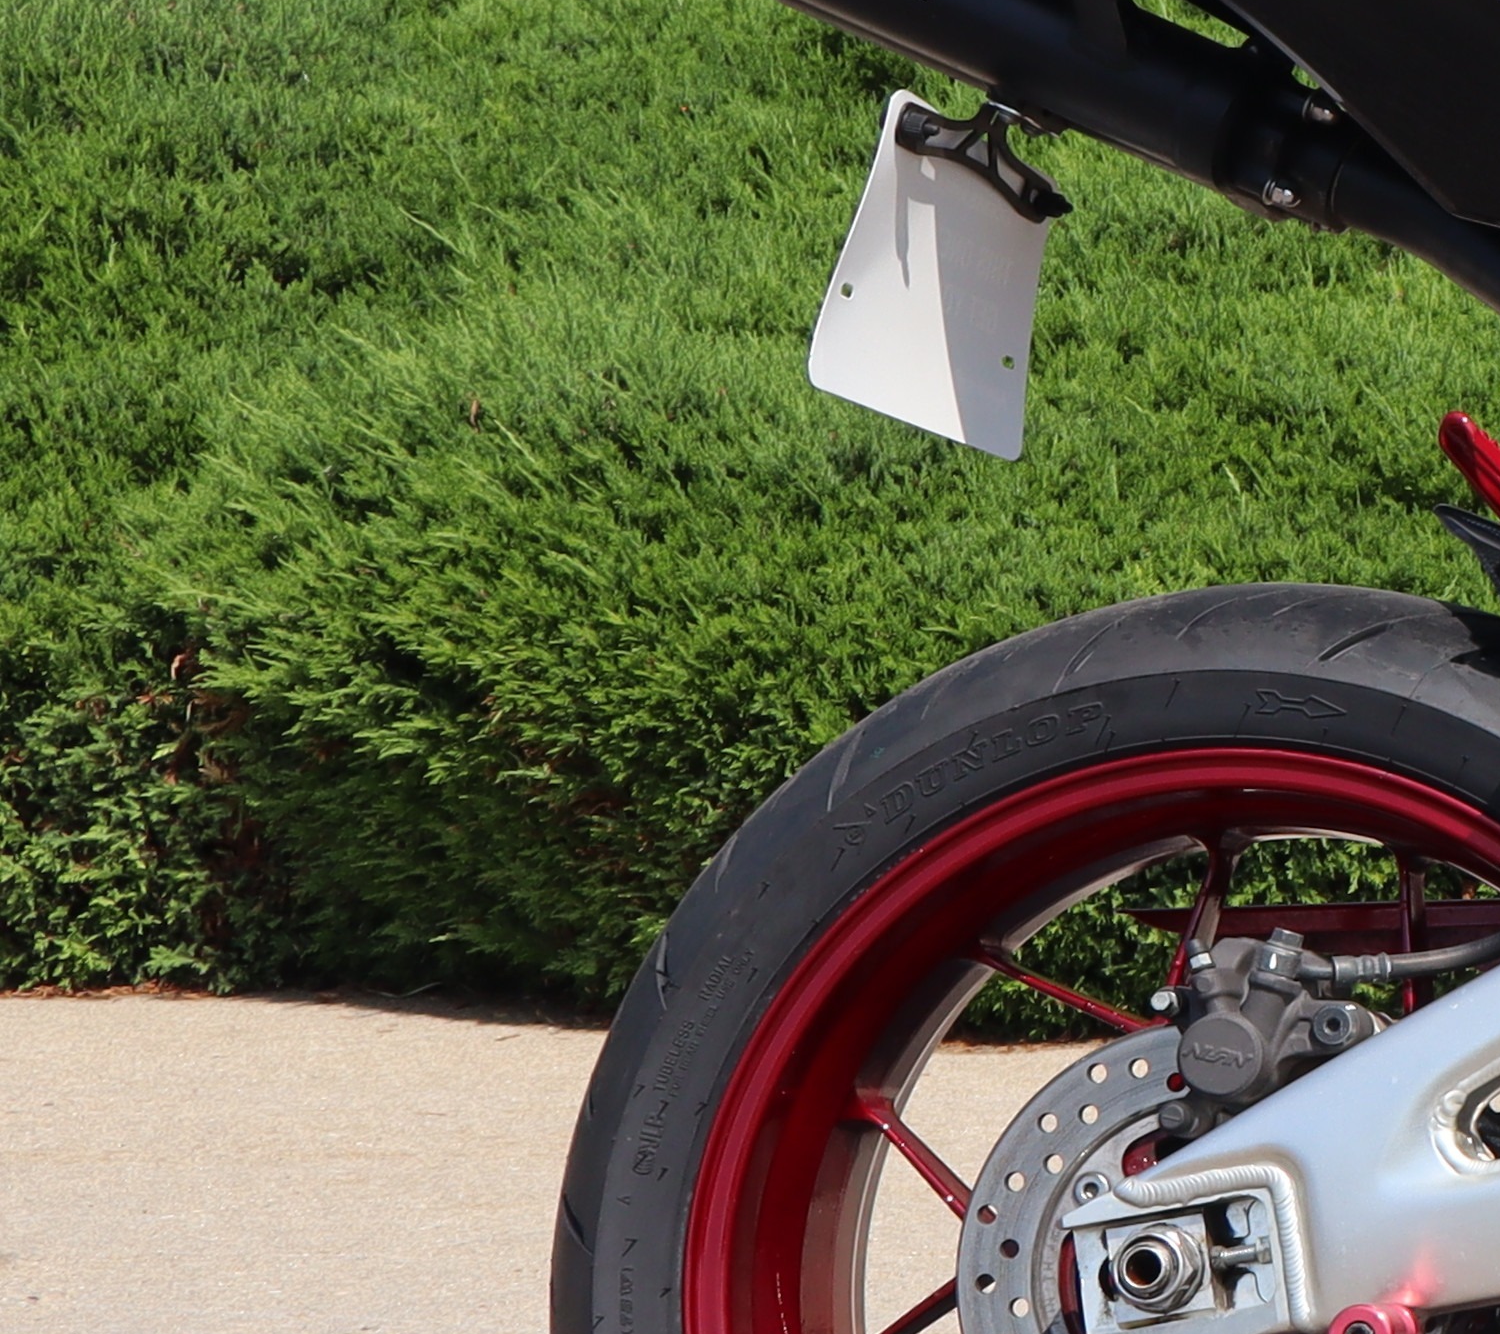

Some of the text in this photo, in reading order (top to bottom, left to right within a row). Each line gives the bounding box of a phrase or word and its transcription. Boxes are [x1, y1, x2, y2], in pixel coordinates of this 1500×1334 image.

[880, 701, 1105, 826] DUNLOP
[697, 953, 737, 1002] RADIAL
[652, 1018, 696, 1091] TUBELESS
